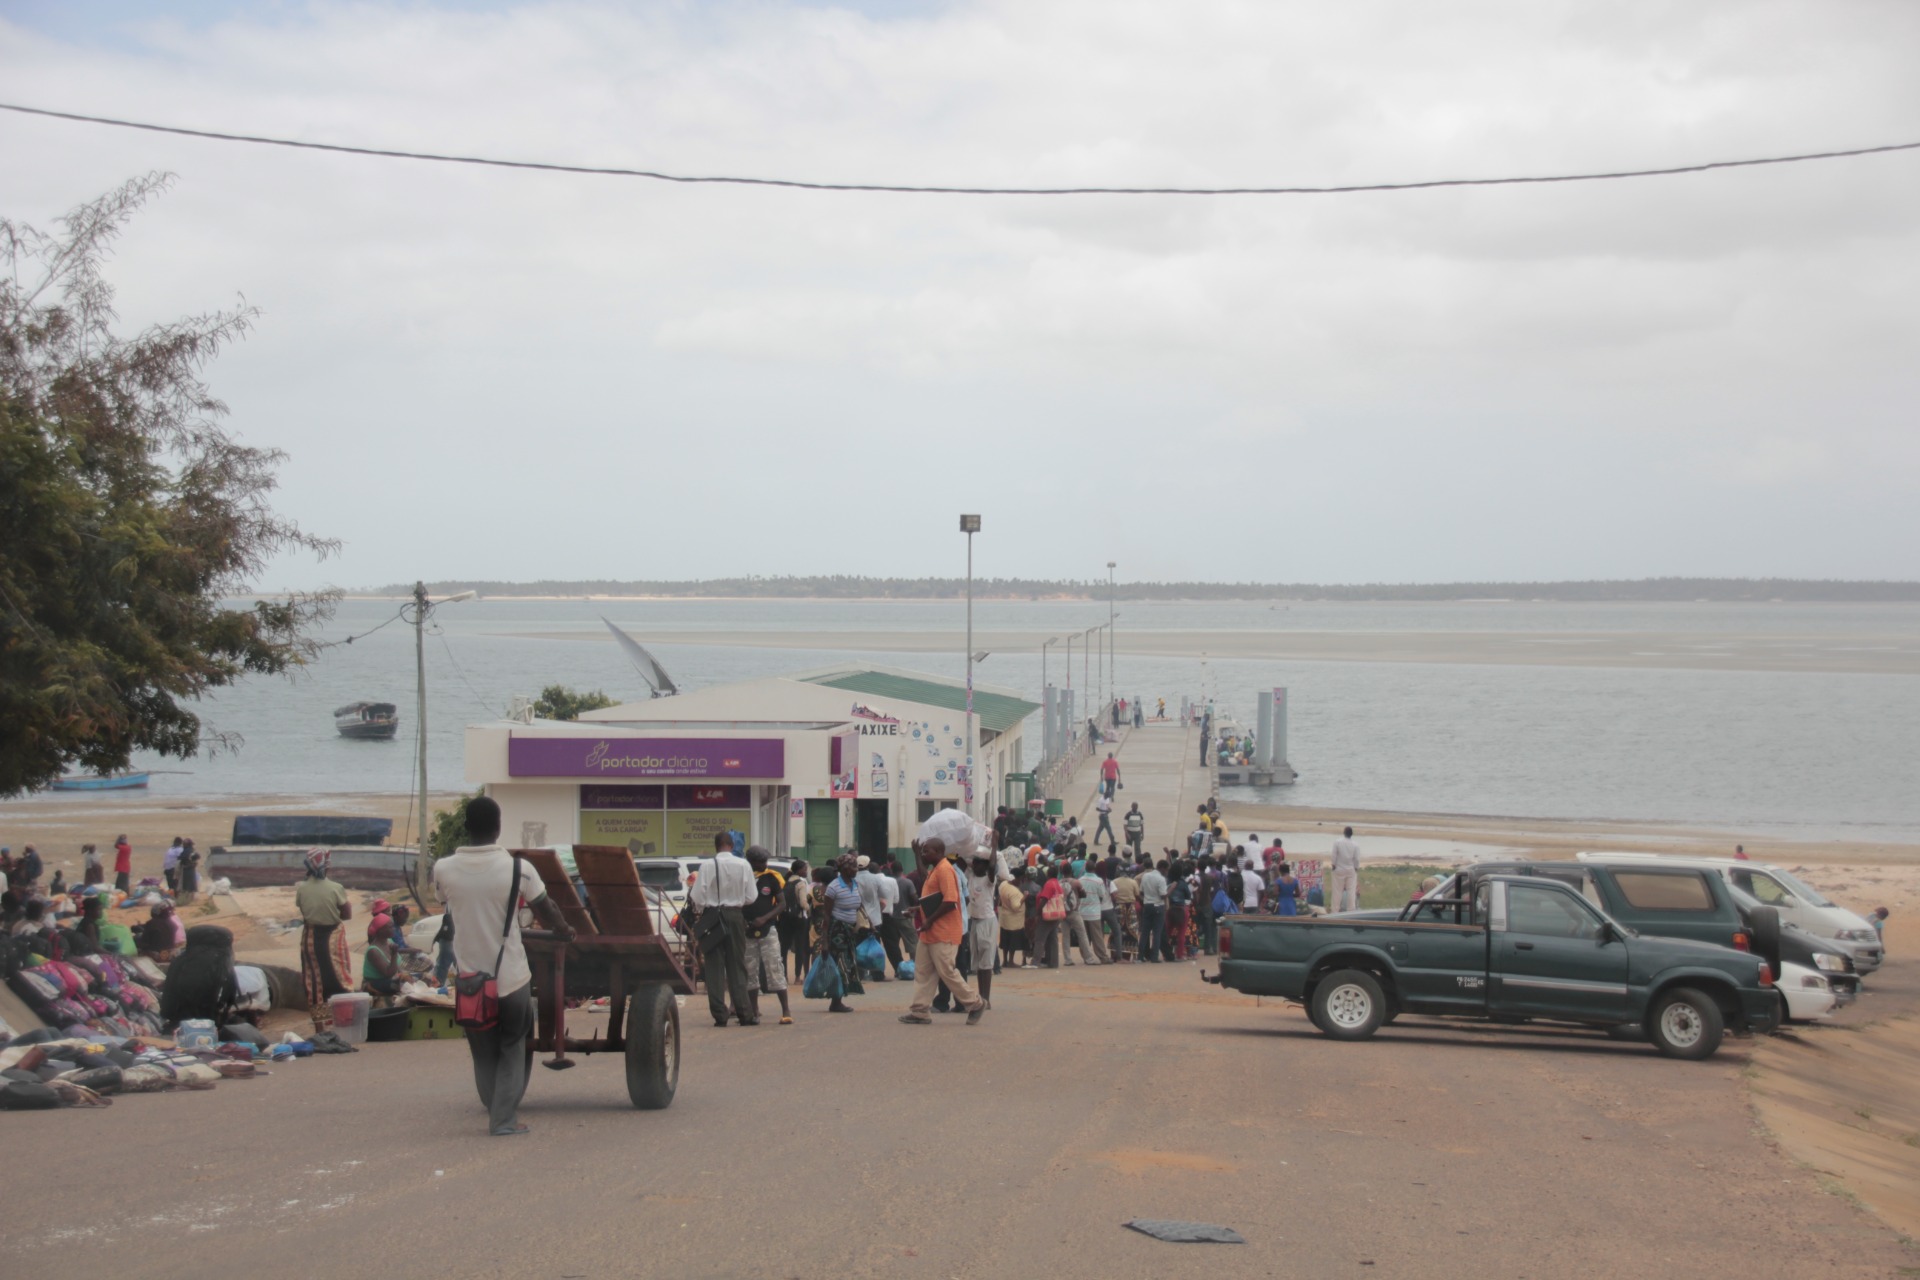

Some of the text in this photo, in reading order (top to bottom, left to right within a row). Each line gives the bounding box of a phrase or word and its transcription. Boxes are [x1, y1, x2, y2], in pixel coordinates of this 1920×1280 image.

[601, 755, 707, 771] portador diário
[602, 818, 622, 826] QUEM
[624, 818, 649, 826] CONFIA
